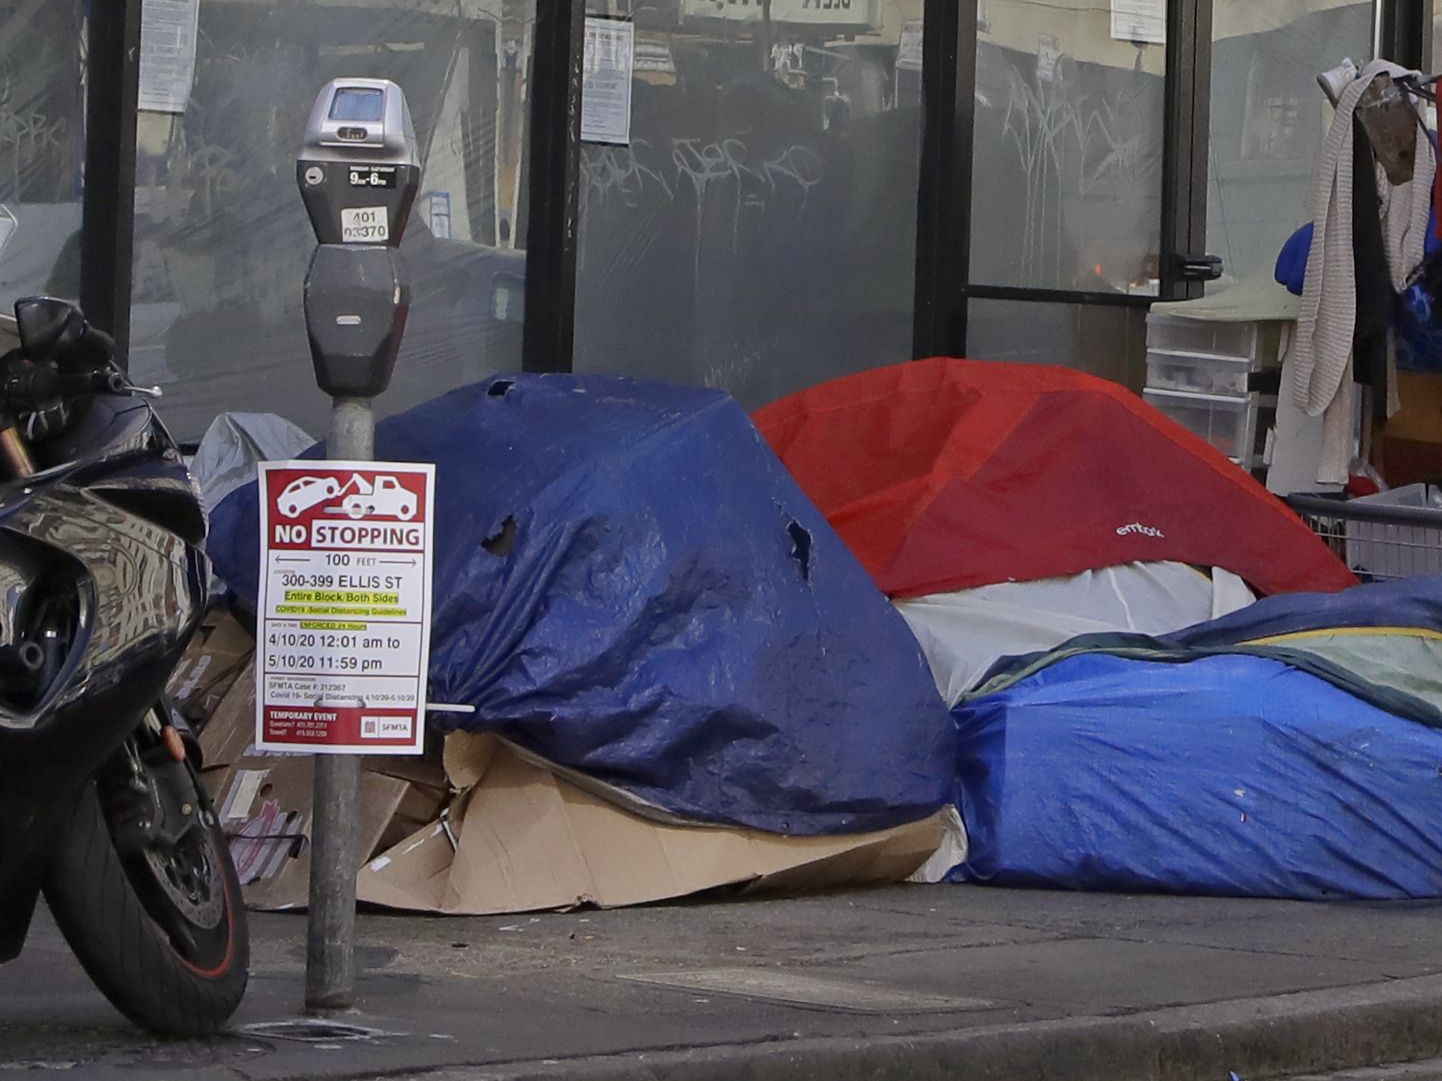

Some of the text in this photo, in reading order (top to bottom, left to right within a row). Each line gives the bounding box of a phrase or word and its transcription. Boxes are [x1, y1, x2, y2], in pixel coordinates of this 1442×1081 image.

[275, 525, 420, 546] NO STOPPING
[326, 553, 377, 566] 100 FEET
[282, 575, 403, 589] 300-399 ELLIS ST
[284, 591, 312, 601] Entire
[373, 593, 399, 603] Sides
[269, 634, 400, 648] 4/10/20 12:01 am to
[268, 655, 382, 671] 5/10/20 11:59 pm
[269, 710, 337, 721] TEMPORARY EVENT
[382, 723, 408, 731] SFMTA
